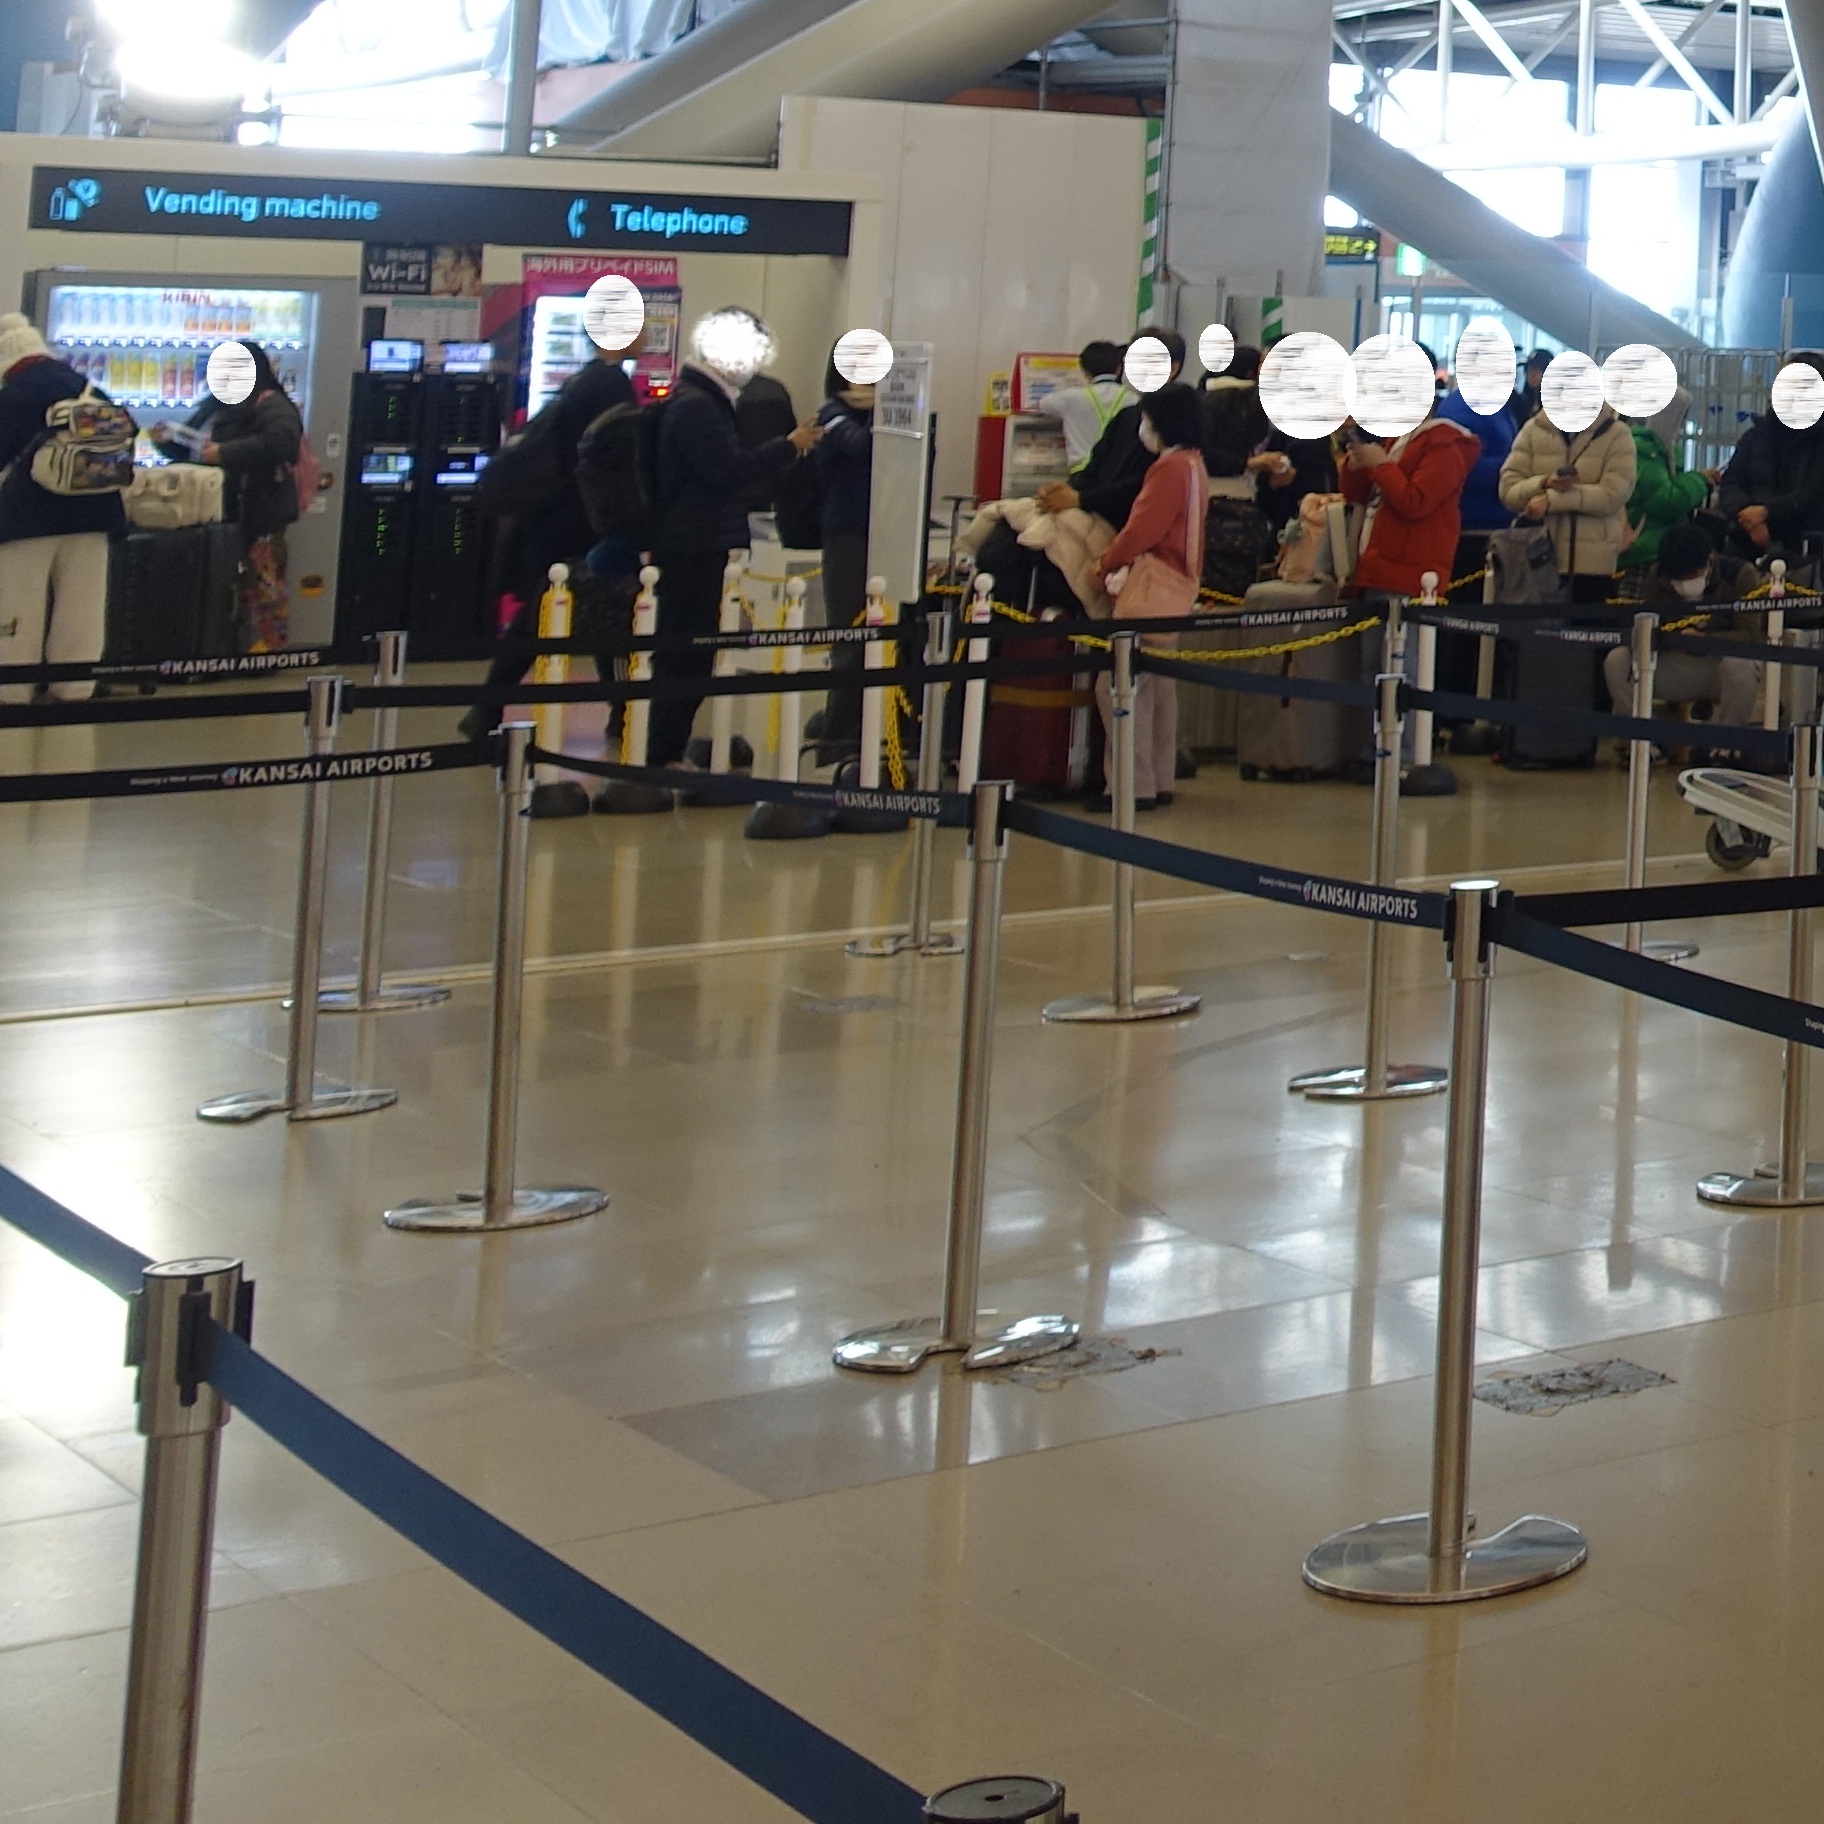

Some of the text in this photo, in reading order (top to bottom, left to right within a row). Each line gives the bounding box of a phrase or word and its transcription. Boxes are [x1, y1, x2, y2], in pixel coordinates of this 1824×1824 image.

[144, 186, 382, 222] Vending machine
[610, 203, 749, 239] Telephone
[367, 261, 426, 281] Wi-Fi
[1250, 612, 1291, 626] KANSAI
[1292, 606, 1348, 623] AIRPORTS
[1740, 599, 1776, 612] KANSAI
[1776, 596, 1822, 609] AIRPORTS
[758, 632, 809, 645] KANSAI
[810, 628, 878, 644] AIRPORTS
[172, 657, 235, 675] KANSAI
[238, 651, 320, 671] AIRPORTS
[239, 761, 321, 784] KANSAI
[326, 751, 433, 777] AIRPORTS
[843, 791, 883, 810] KANSAI
[885, 795, 941, 815] AIRPORTS
[1310, 882, 1356, 909] KANSAI
[1357, 892, 1418, 919] AIRPORTS
